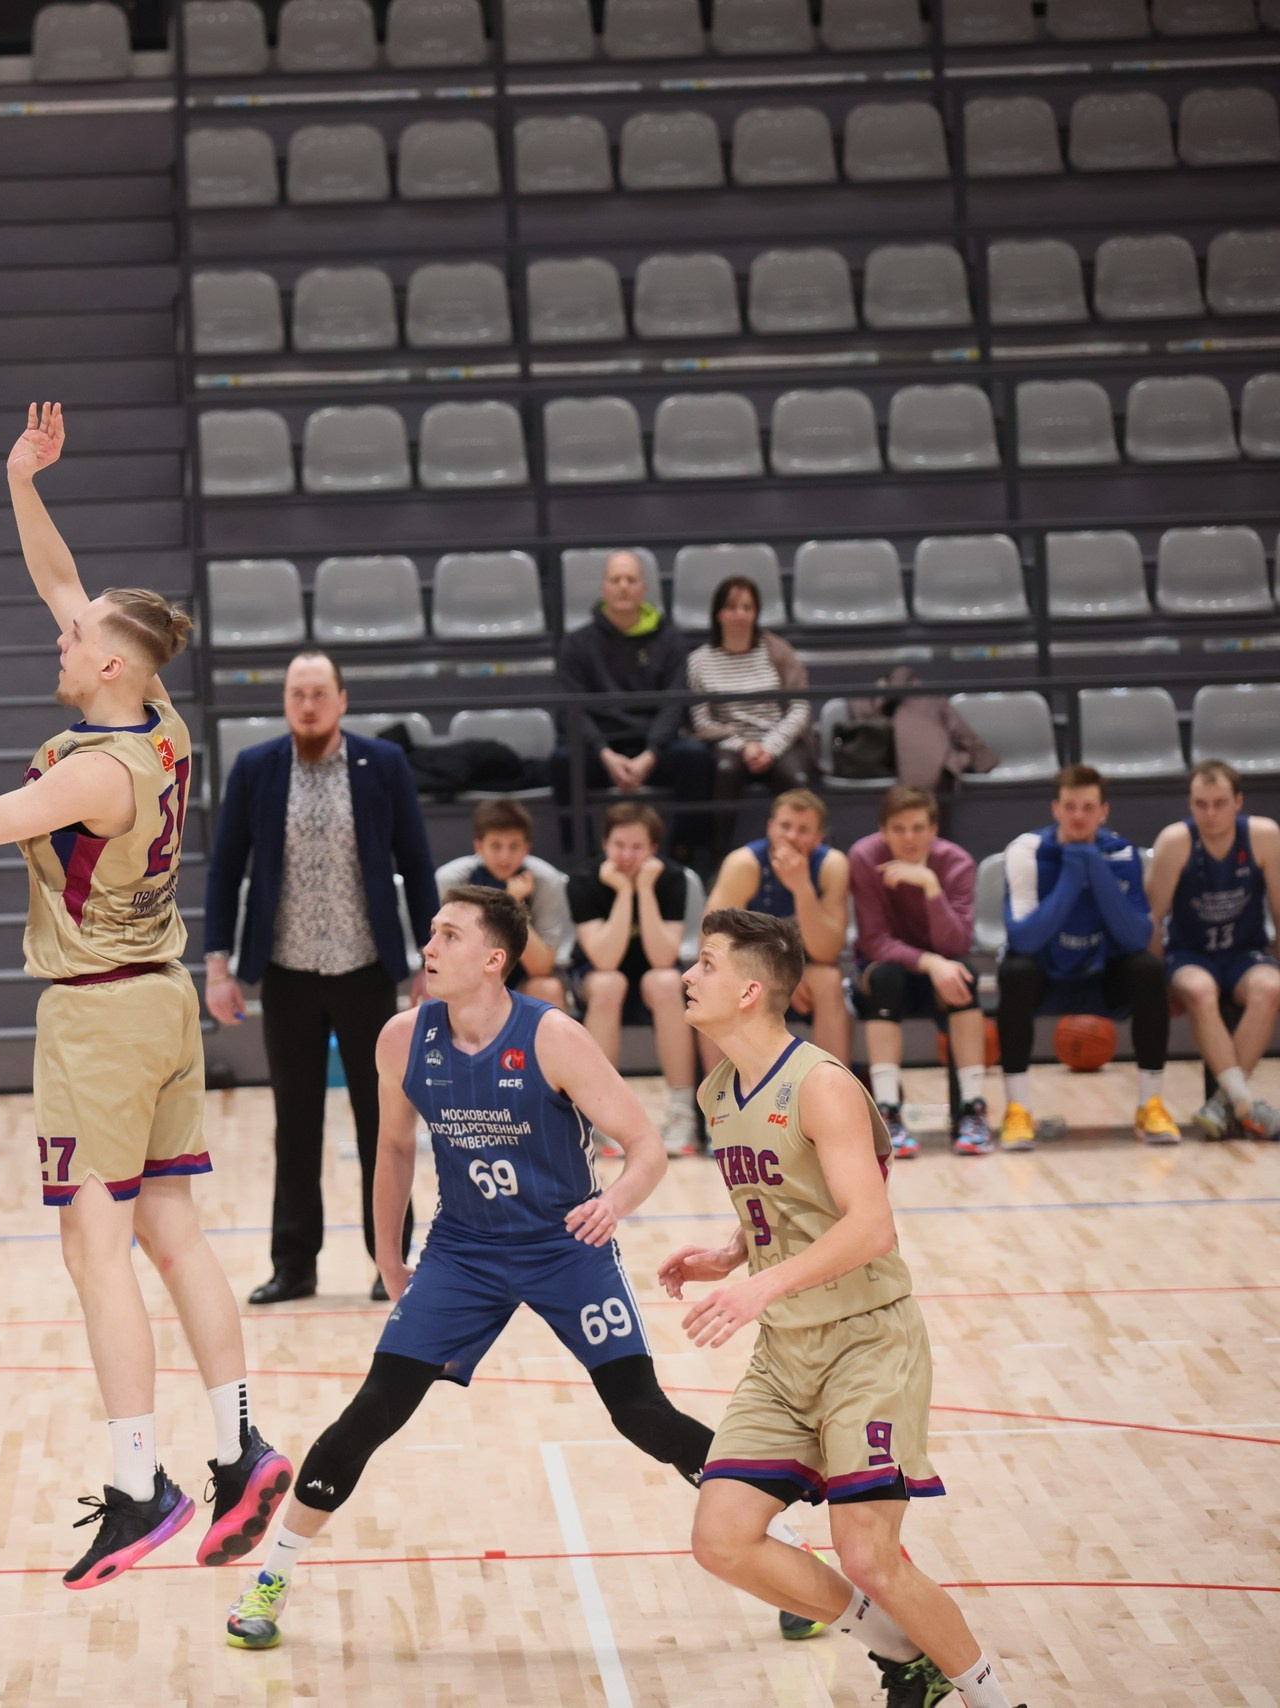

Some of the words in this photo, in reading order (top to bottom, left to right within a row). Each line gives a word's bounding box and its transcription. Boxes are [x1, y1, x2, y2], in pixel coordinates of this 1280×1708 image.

[429, 1121, 532, 1136] ГОСУДАРСТВЕННЫЙ
[440, 1108, 512, 1123] МОСКОВСКИЙ
[447, 1135, 520, 1149] УНИВЕРСИТЕТ
[468, 1159, 518, 1200] 69
[746, 1199, 772, 1246] 9
[580, 1296, 633, 1345] 69
[865, 1421, 895, 1467] 9
